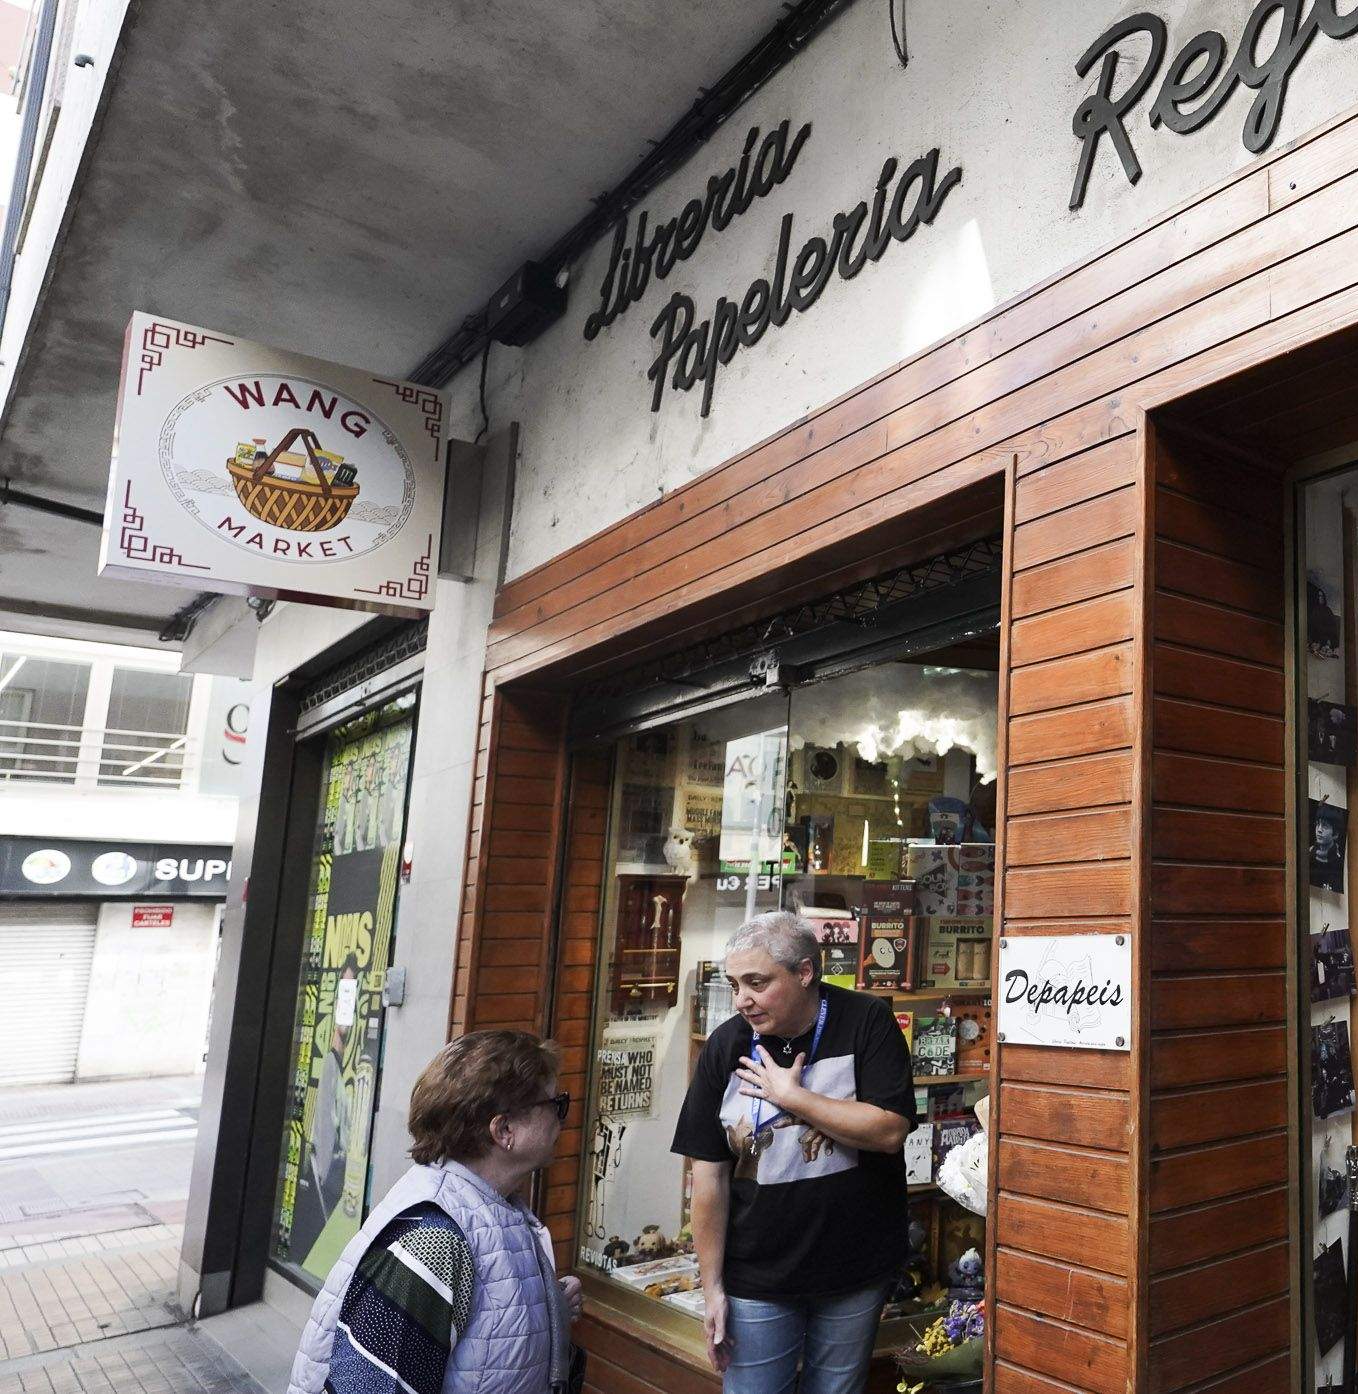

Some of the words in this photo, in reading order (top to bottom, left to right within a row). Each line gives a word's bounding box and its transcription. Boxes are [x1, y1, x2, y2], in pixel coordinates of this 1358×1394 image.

[583, 119, 812, 341] Librería
[647, 147, 963, 418] Papelería
[224, 379, 372, 440] WANG
[216, 515, 356, 561] MARKET
[871, 921, 904, 930] BURRITO
[938, 925, 985, 935] BURRITO
[1005, 968, 1123, 1015] Depapeis
[627, 1050, 654, 1065] WHO
[918, 1046, 951, 1058] CODE
[602, 1065, 630, 1080] MUST
[631, 1064, 653, 1078] NOT
[601, 1080, 615, 1095] BE
[615, 1076, 652, 1093] NAMED
[600, 1090, 651, 1112] RETURNS
